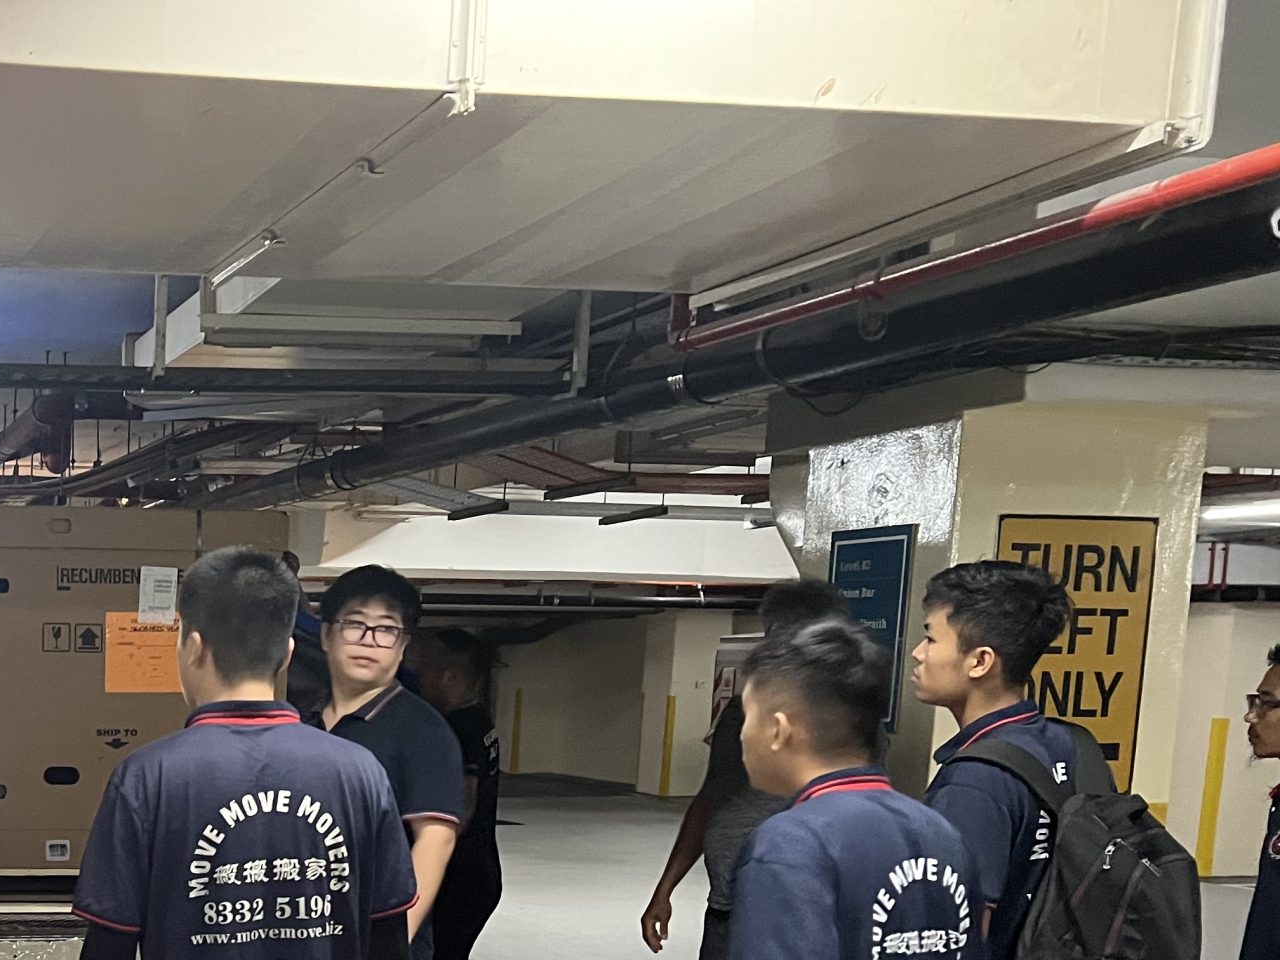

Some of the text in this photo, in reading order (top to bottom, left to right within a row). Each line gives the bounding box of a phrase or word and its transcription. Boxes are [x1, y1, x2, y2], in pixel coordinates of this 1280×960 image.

[60, 567, 140, 585] RECUMBEN
[1011, 543, 1141, 592] TURN
[96, 729, 138, 737] SHIP TO
[188, 789, 351, 899] MOVE MOVE MOVERS
[203, 894, 332, 925] 8332 5196
